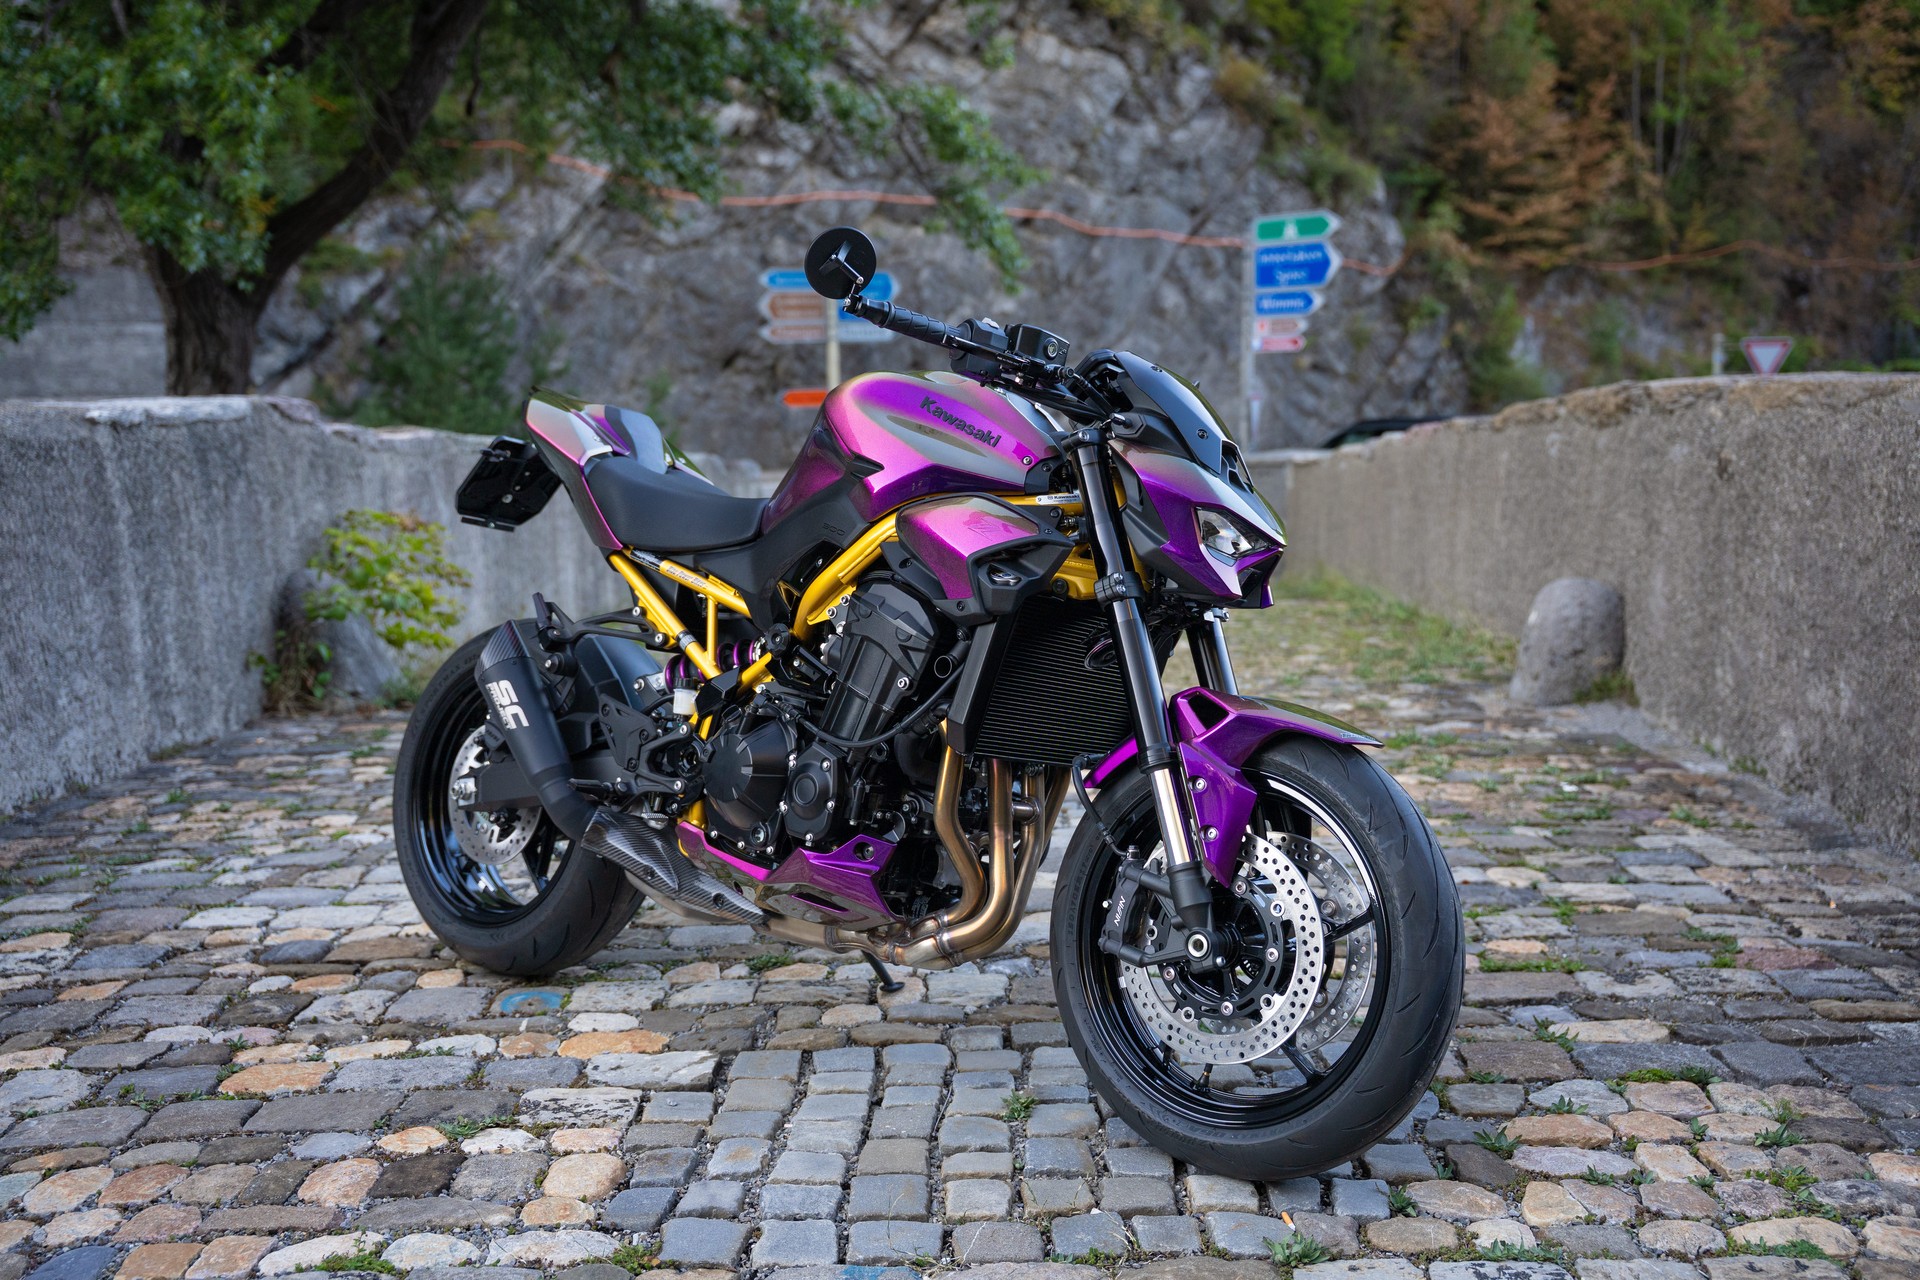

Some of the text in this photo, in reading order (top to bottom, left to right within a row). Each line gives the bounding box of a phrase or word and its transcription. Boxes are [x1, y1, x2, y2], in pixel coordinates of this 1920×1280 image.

[919, 396, 1002, 448] Kawasaki
[485, 682, 513, 730] PROJECT
[493, 679, 530, 729] SC
[1113, 895, 1126, 927] NISSIN
